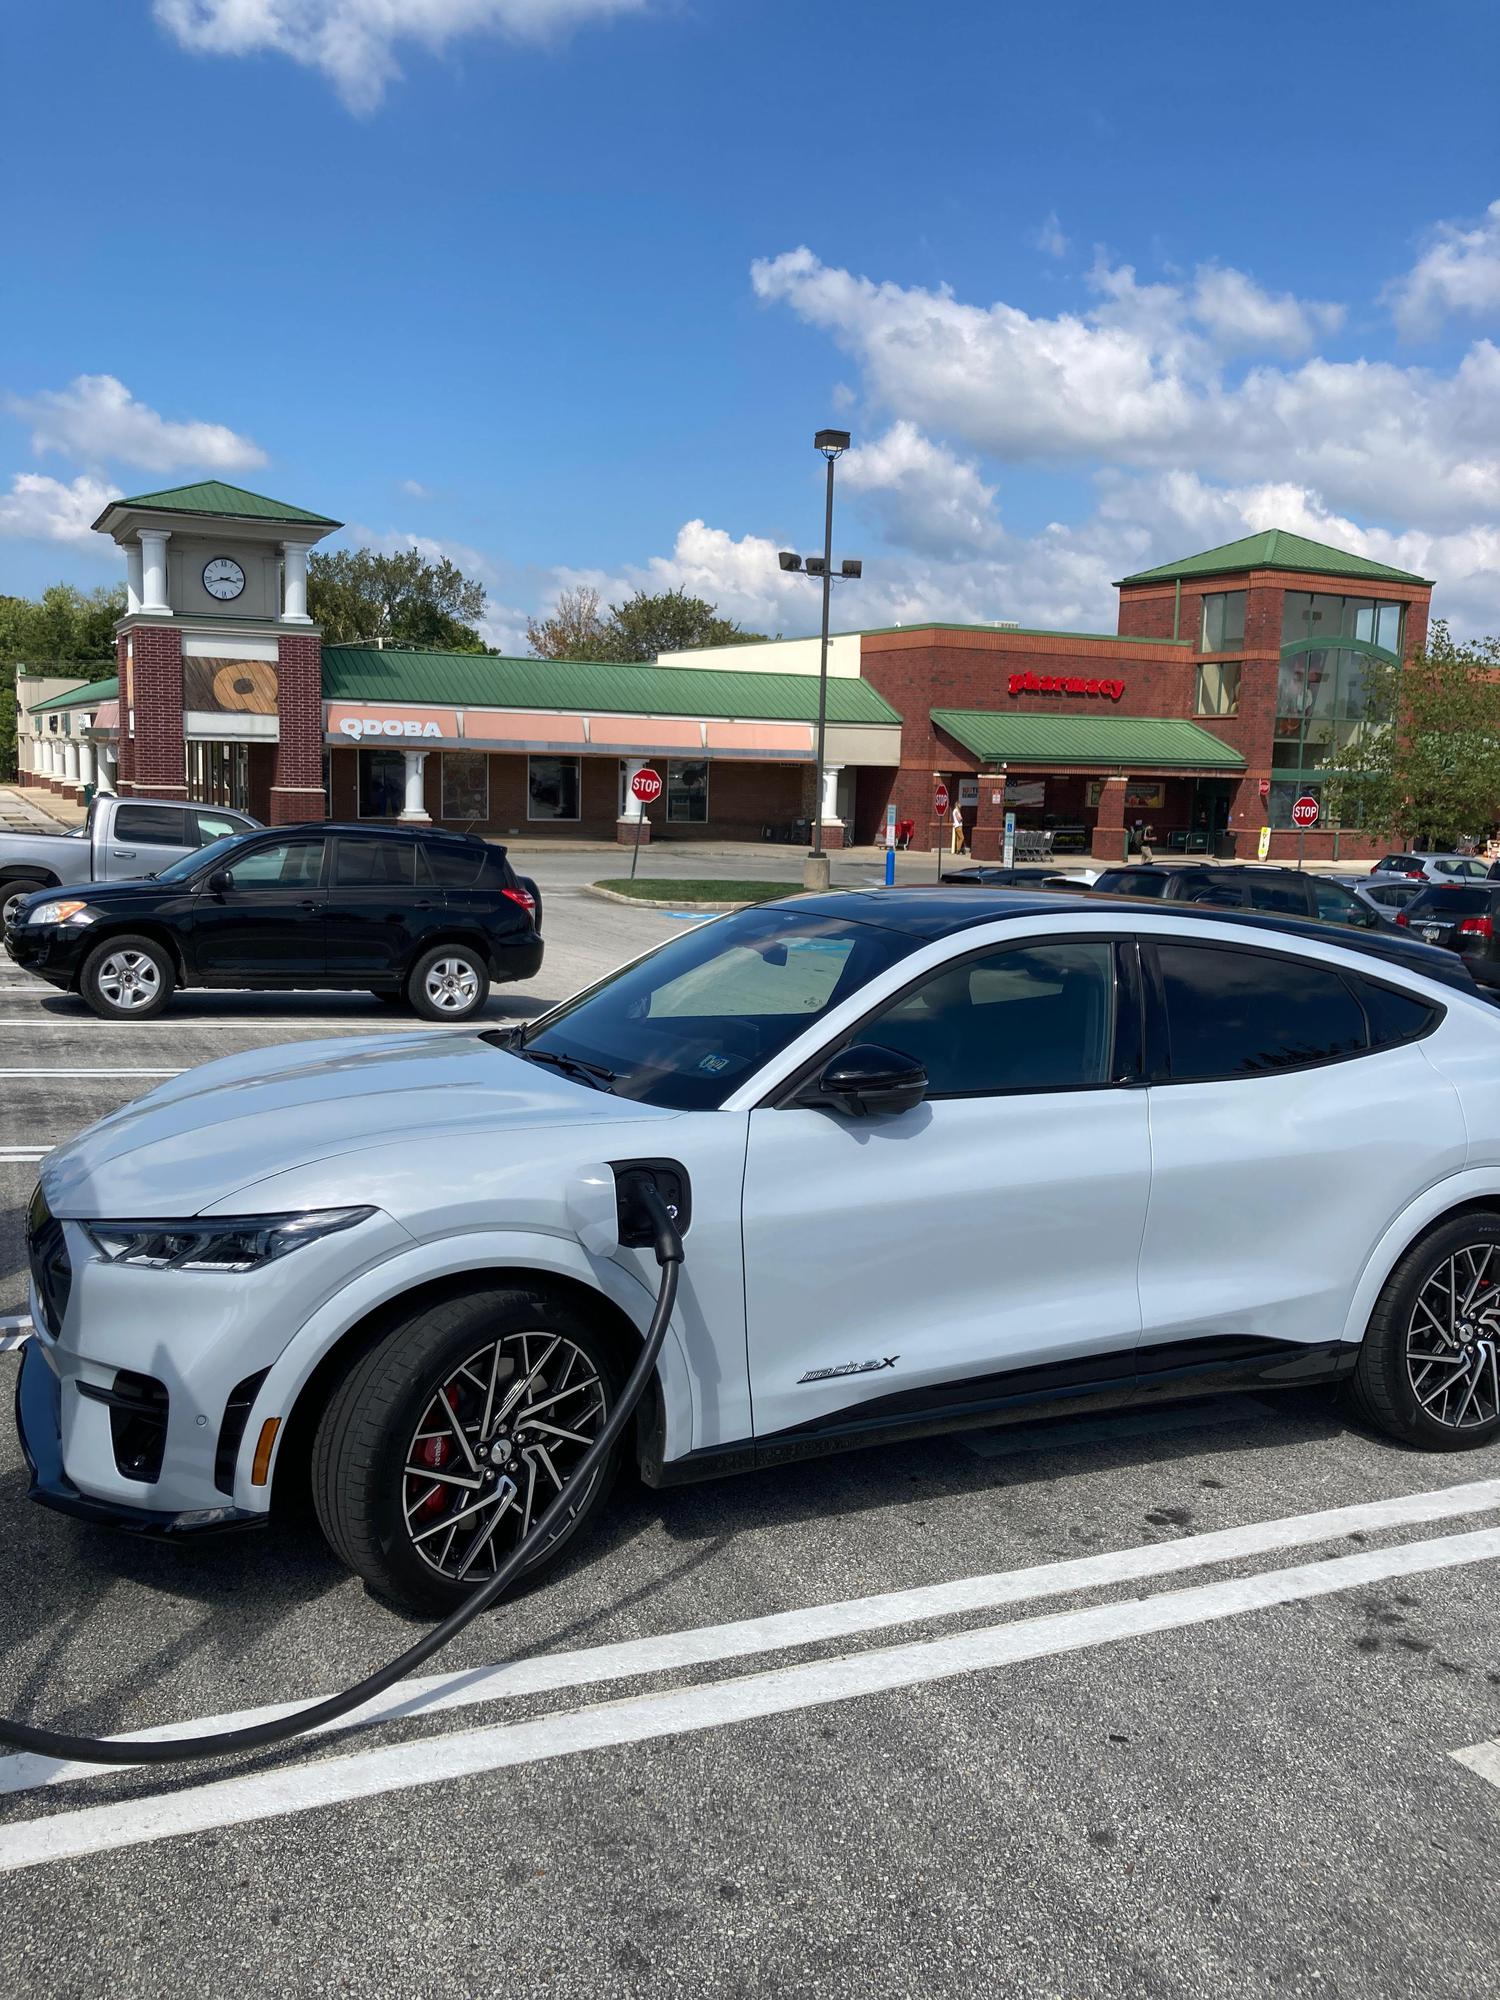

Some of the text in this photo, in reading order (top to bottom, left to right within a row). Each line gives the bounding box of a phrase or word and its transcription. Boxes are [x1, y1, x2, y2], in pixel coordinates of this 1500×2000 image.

[1008, 671, 1125, 699] pharmacy
[339, 718, 443, 740] QDOBA
[633, 778, 660, 793] STOP
[936, 795, 947, 806] STOP
[1295, 806, 1317, 818] STOP
